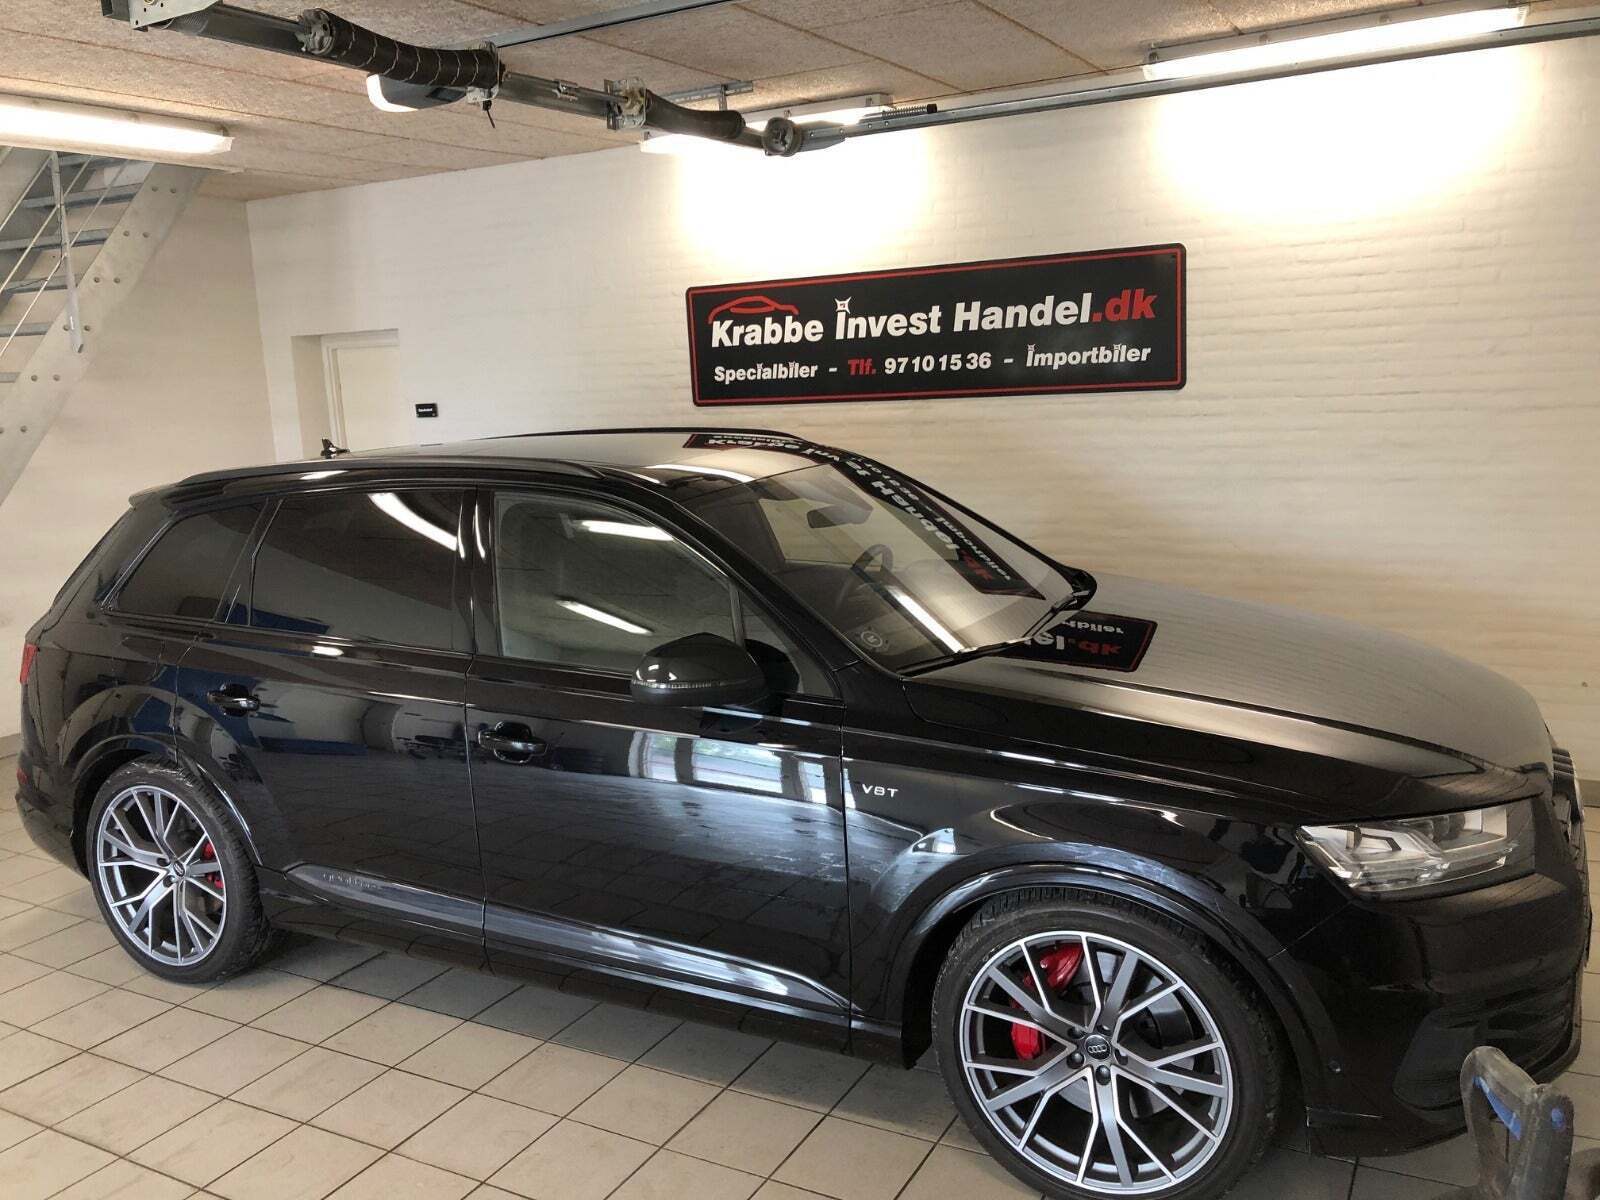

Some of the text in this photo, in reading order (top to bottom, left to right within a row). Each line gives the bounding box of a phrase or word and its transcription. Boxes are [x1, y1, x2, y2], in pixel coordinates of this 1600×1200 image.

[711, 288, 1158, 348] Krabbe Invest Handel.dk
[713, 360, 819, 385] Specialbiler
[847, 358, 876, 375] Tlf.
[1025, 343, 1152, 371] Importbiler
[861, 783, 899, 798] V8T
